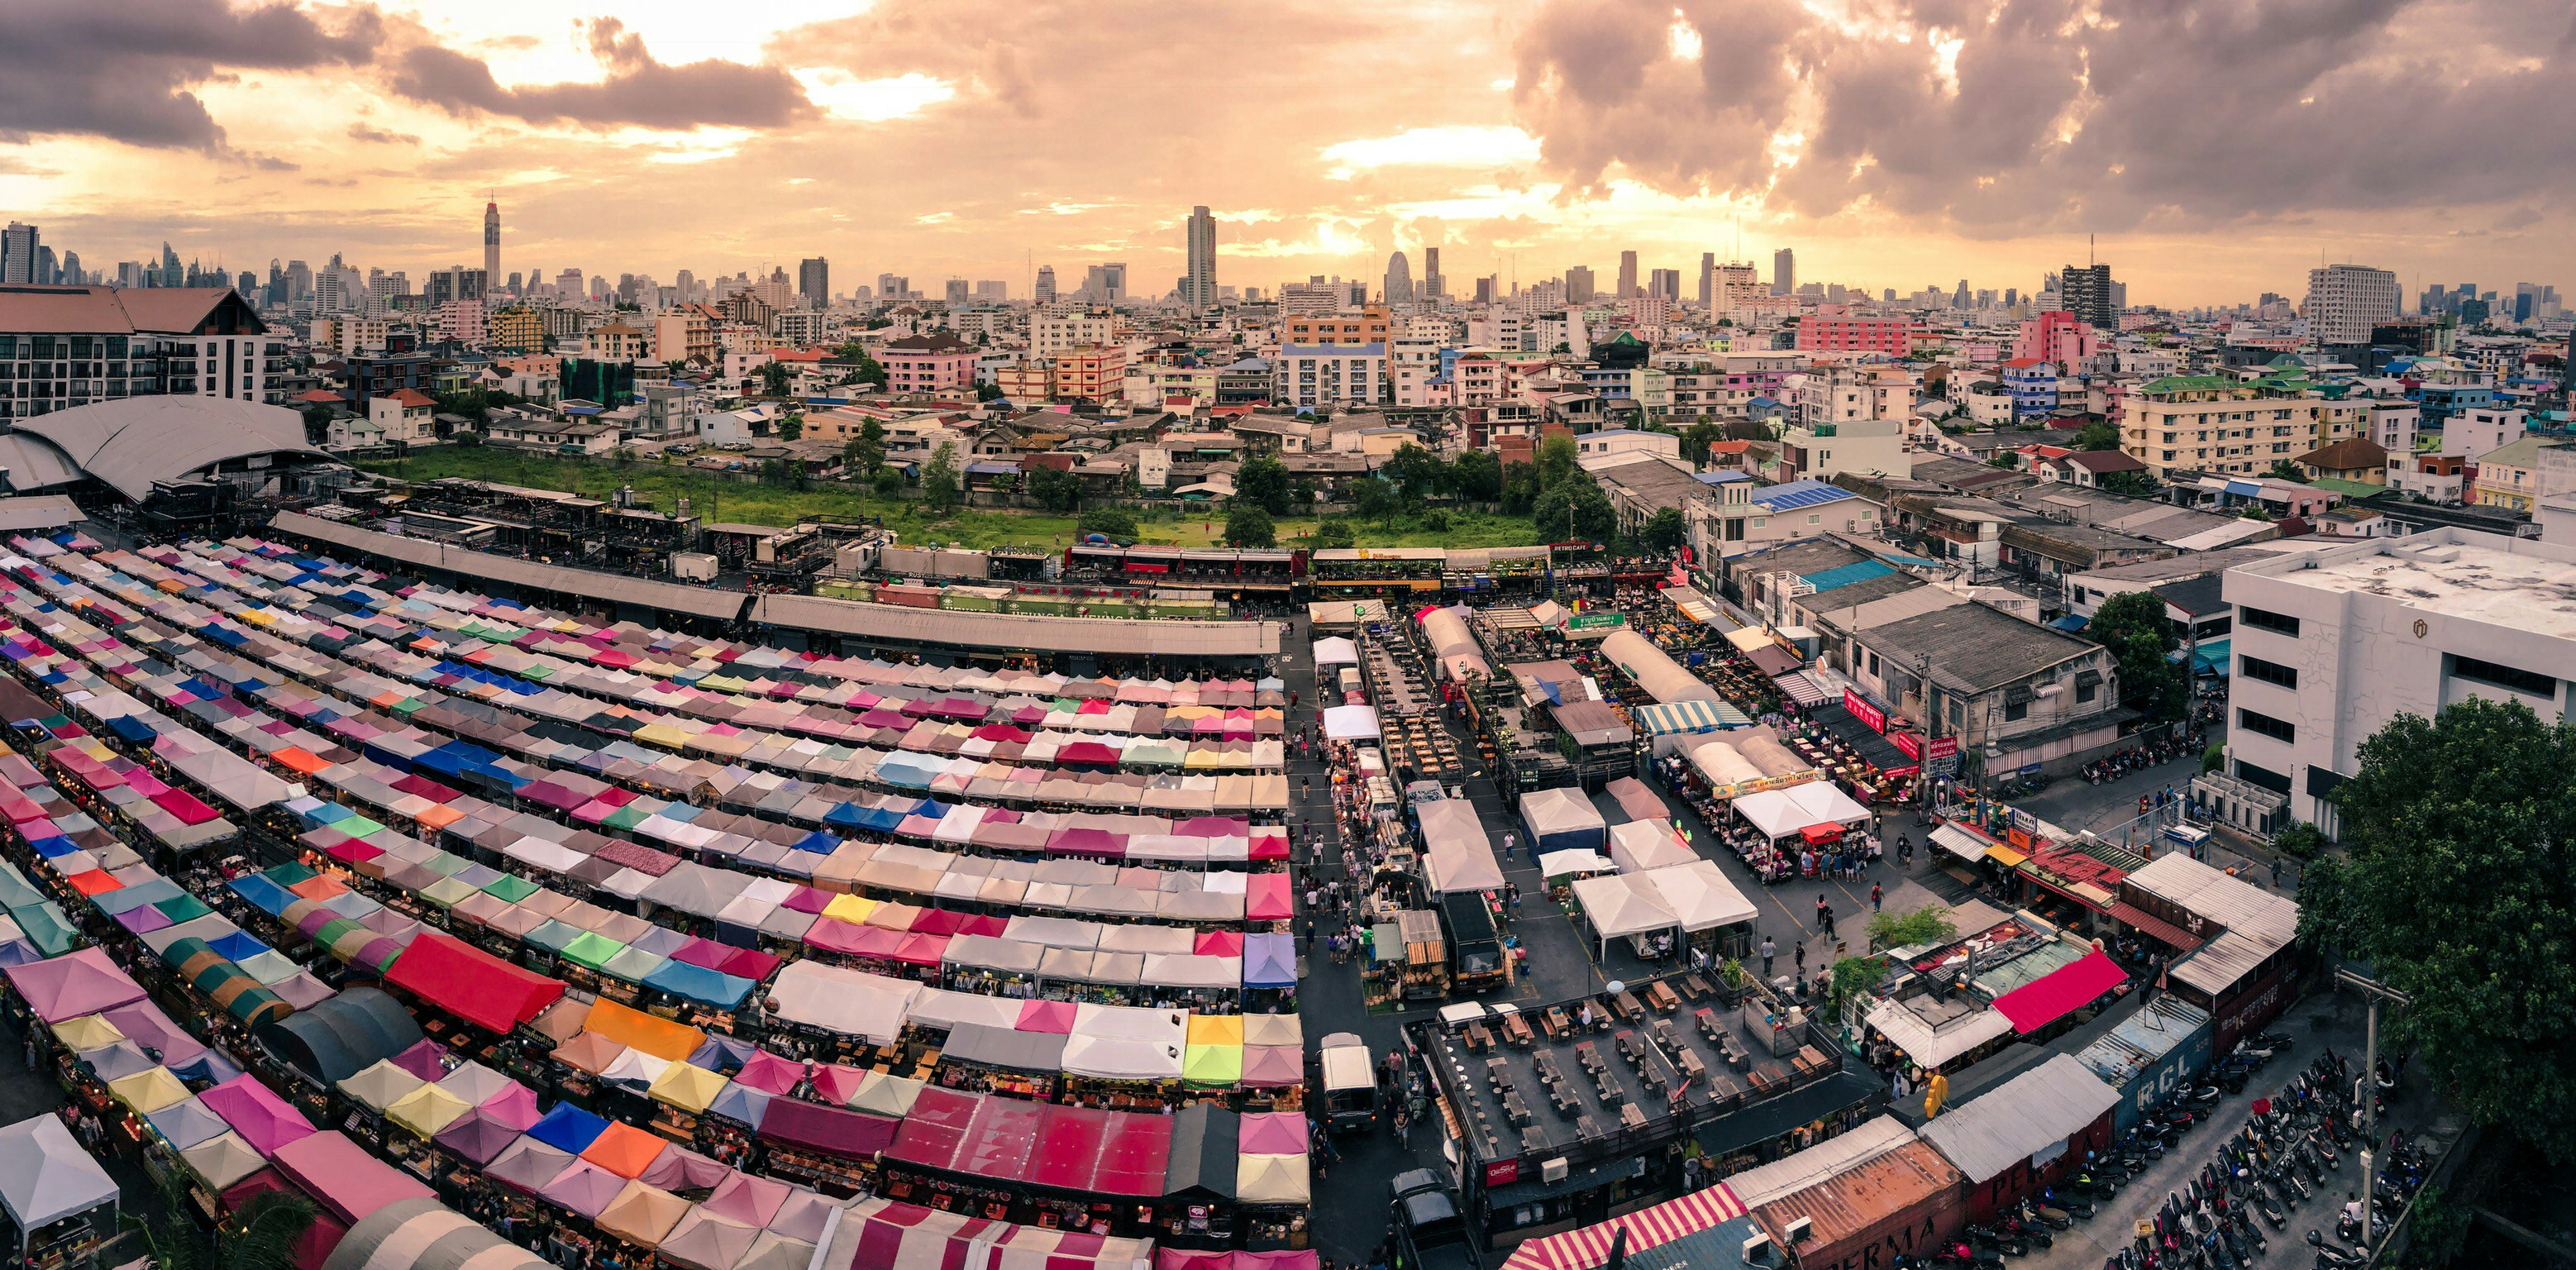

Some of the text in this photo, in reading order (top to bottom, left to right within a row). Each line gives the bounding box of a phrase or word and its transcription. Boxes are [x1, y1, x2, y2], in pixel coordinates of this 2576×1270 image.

[1847, 692, 1882, 721] THAI FRUIT BUFFET
[2137, 1053, 2191, 1111] RCL
[1992, 1130, 2096, 1205] PERA
